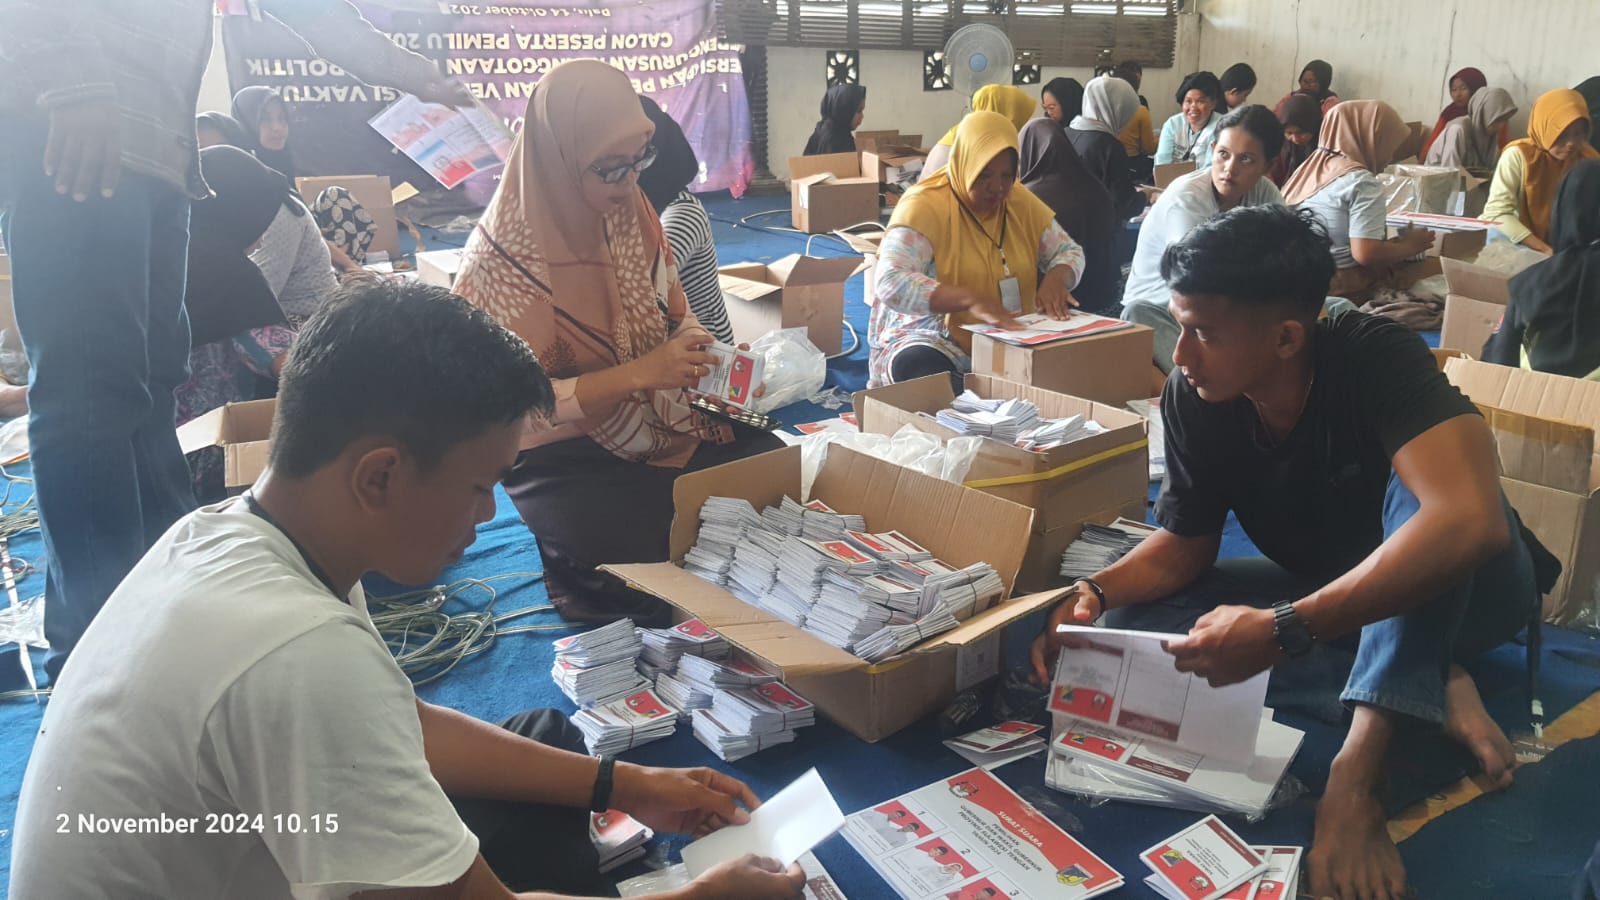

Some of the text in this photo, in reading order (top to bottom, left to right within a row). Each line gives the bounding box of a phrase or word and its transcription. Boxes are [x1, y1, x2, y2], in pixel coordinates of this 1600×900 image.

[443, 4, 481, 16] 202
[427, 33, 510, 50] PEMILU
[515, 33, 606, 50] PESERTA
[611, 33, 673, 49] CALON
[998, 811, 1043, 847] SURAT SUARA
[1012, 847, 1043, 872] GUBERNUR
